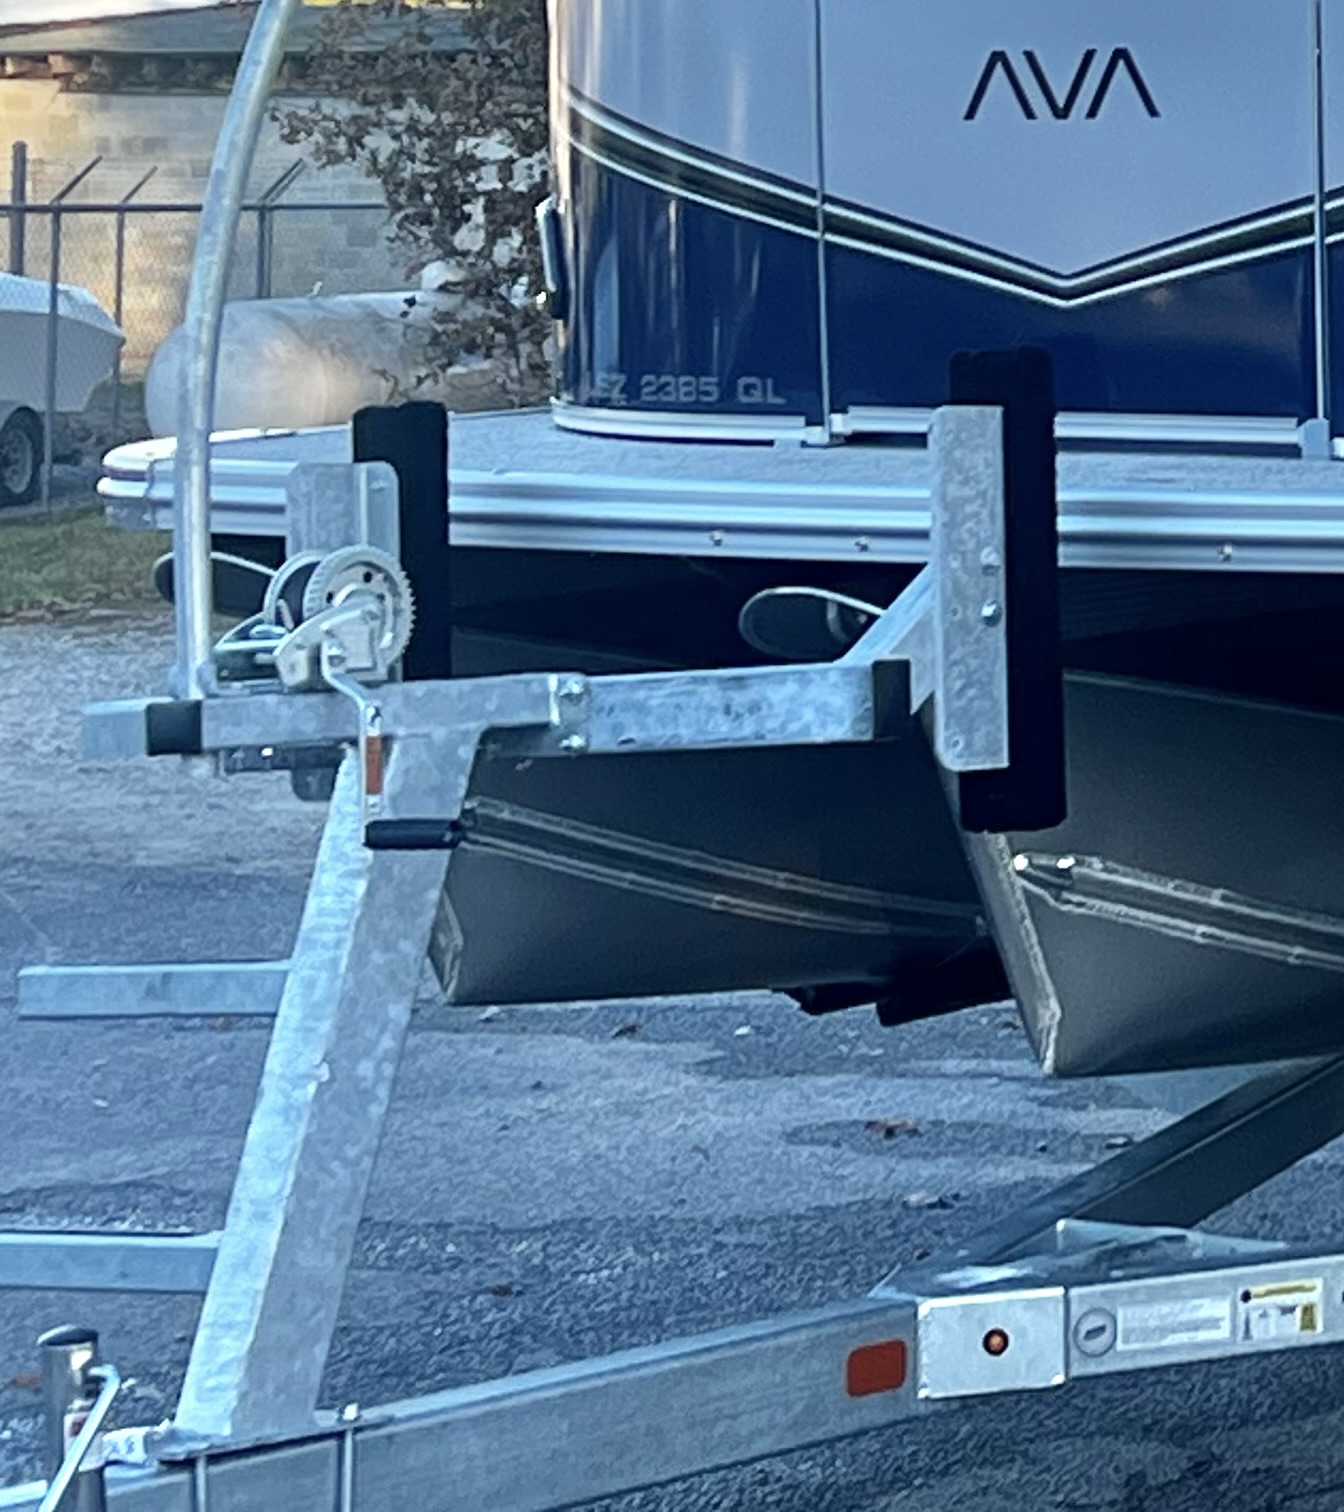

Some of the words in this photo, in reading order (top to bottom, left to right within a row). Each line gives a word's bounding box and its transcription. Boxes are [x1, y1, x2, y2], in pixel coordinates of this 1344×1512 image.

[963, 47, 1161, 120] AVA
[640, 374, 719, 403] 2385
[737, 376, 787, 405] QL
